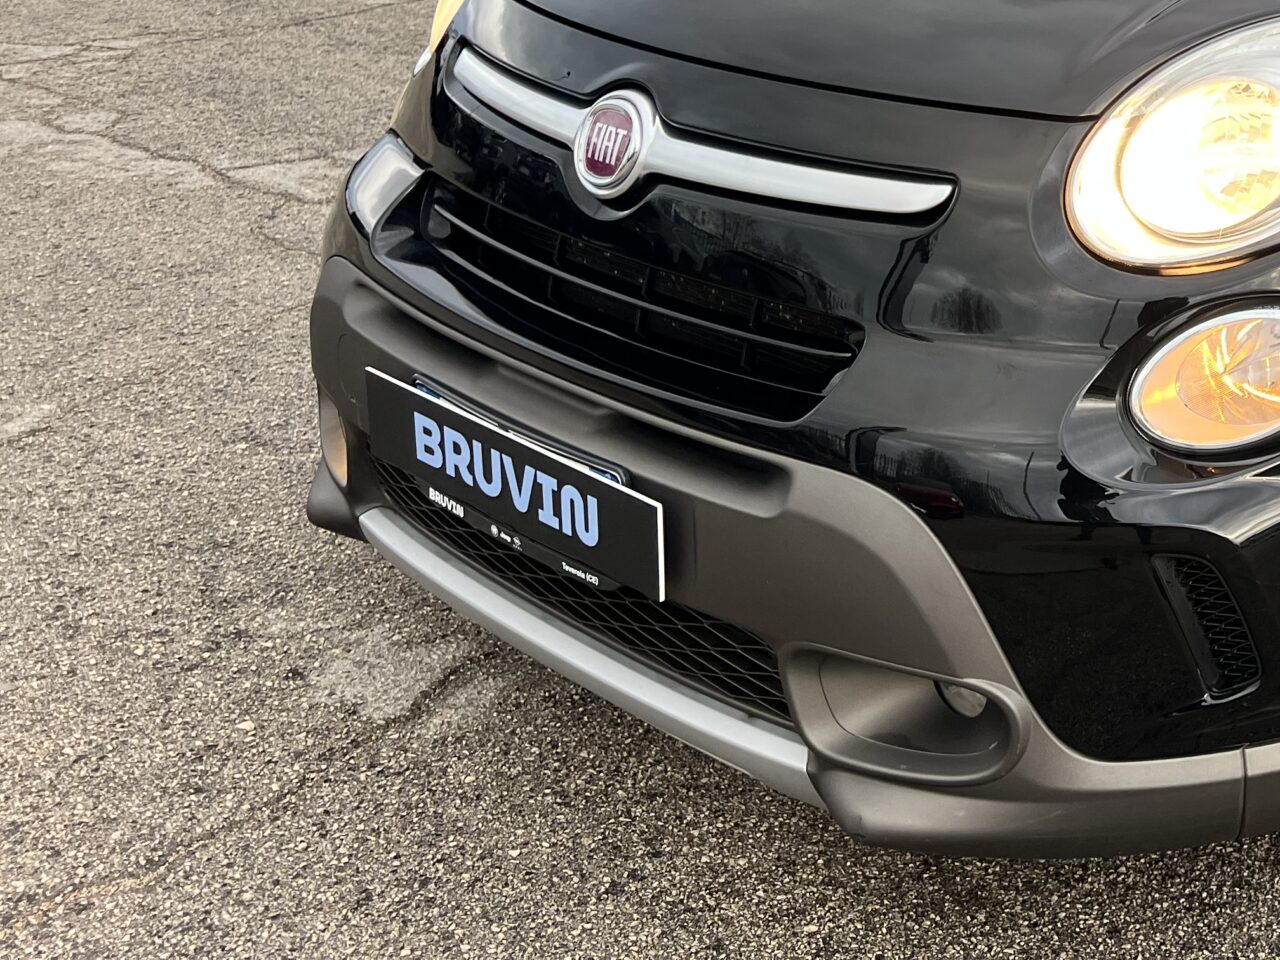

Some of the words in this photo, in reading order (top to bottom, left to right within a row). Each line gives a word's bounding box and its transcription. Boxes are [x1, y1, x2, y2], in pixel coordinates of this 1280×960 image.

[586, 121, 628, 166] FIAT
[413, 410, 600, 548] BRUVIN
[428, 486, 465, 519] BRUVIN
